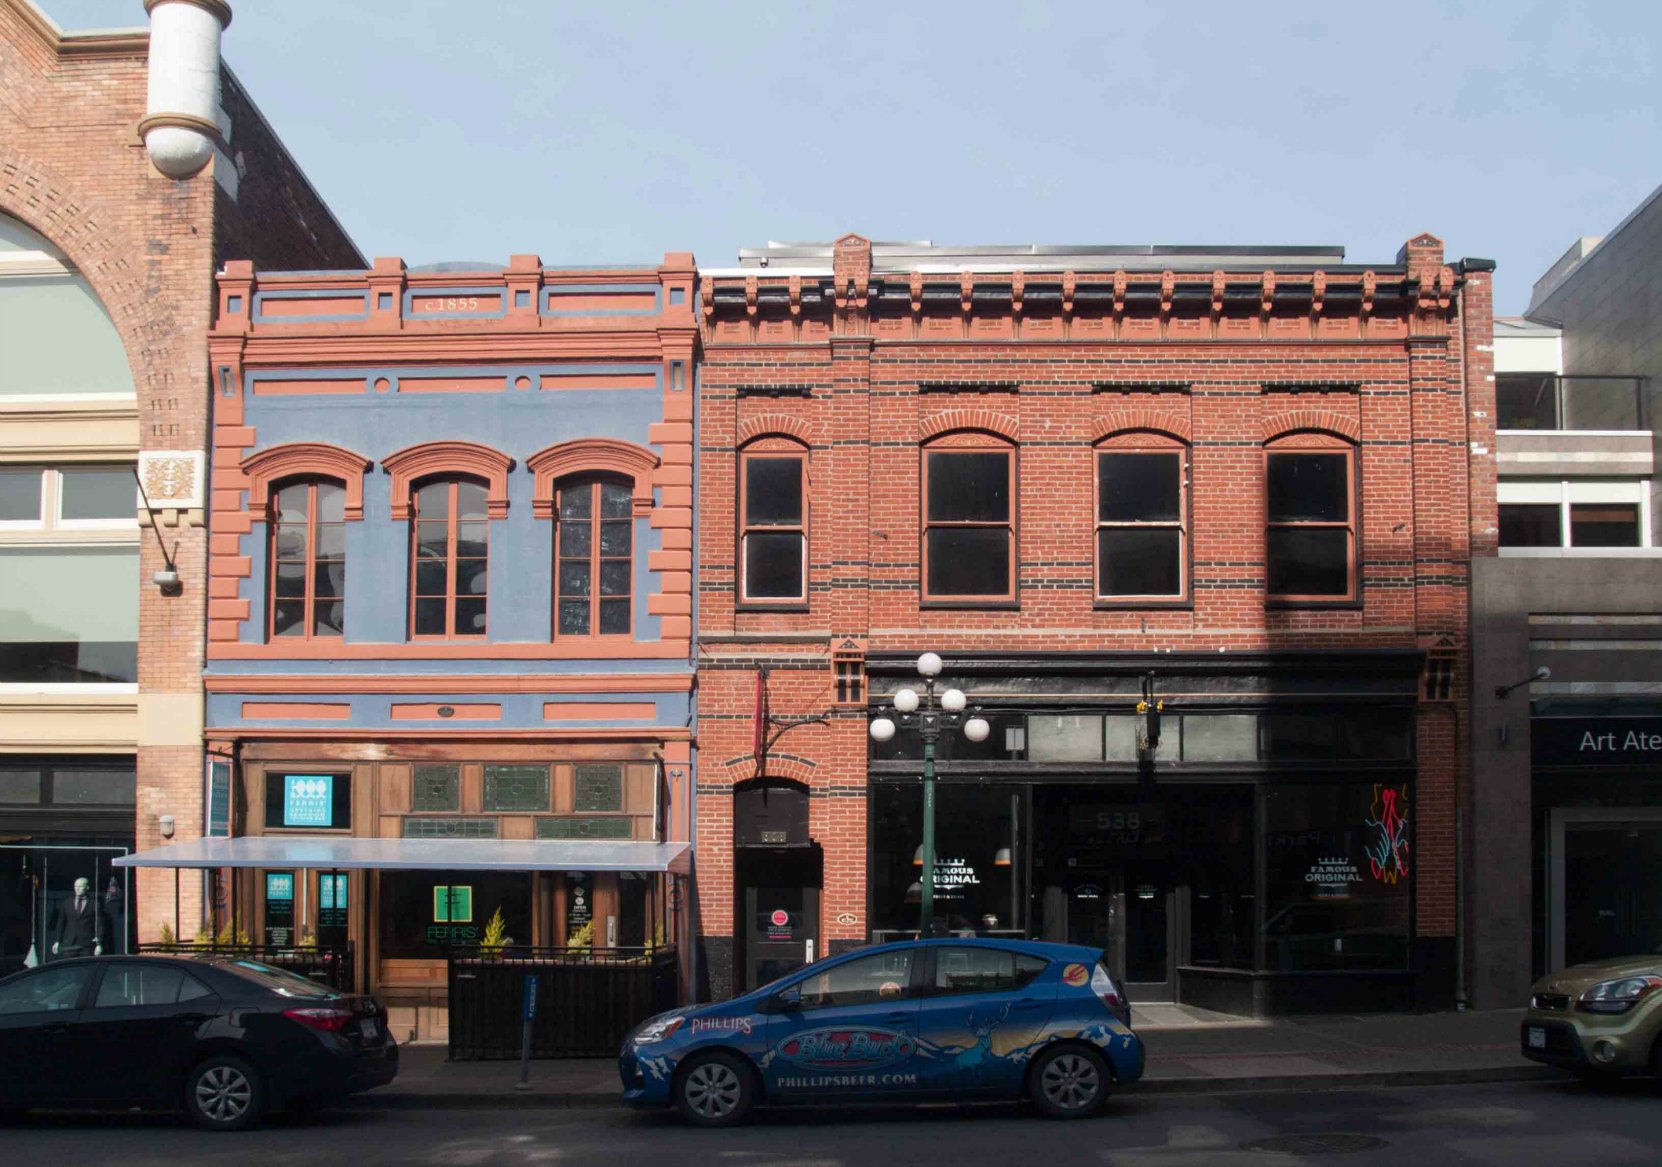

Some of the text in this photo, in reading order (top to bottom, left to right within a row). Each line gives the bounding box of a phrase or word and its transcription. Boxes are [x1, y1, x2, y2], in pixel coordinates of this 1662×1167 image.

[1579, 731, 1617, 751] Art
[1096, 812, 1141, 830] 538
[932, 867, 975, 875] AMOUS
[1304, 873, 1364, 882] ORIGINAL
[691, 1017, 752, 1035] PHILLIPS
[799, 1033, 847, 1060] Blue
[777, 1073, 917, 1088] PHILLIPSBEER.COM
